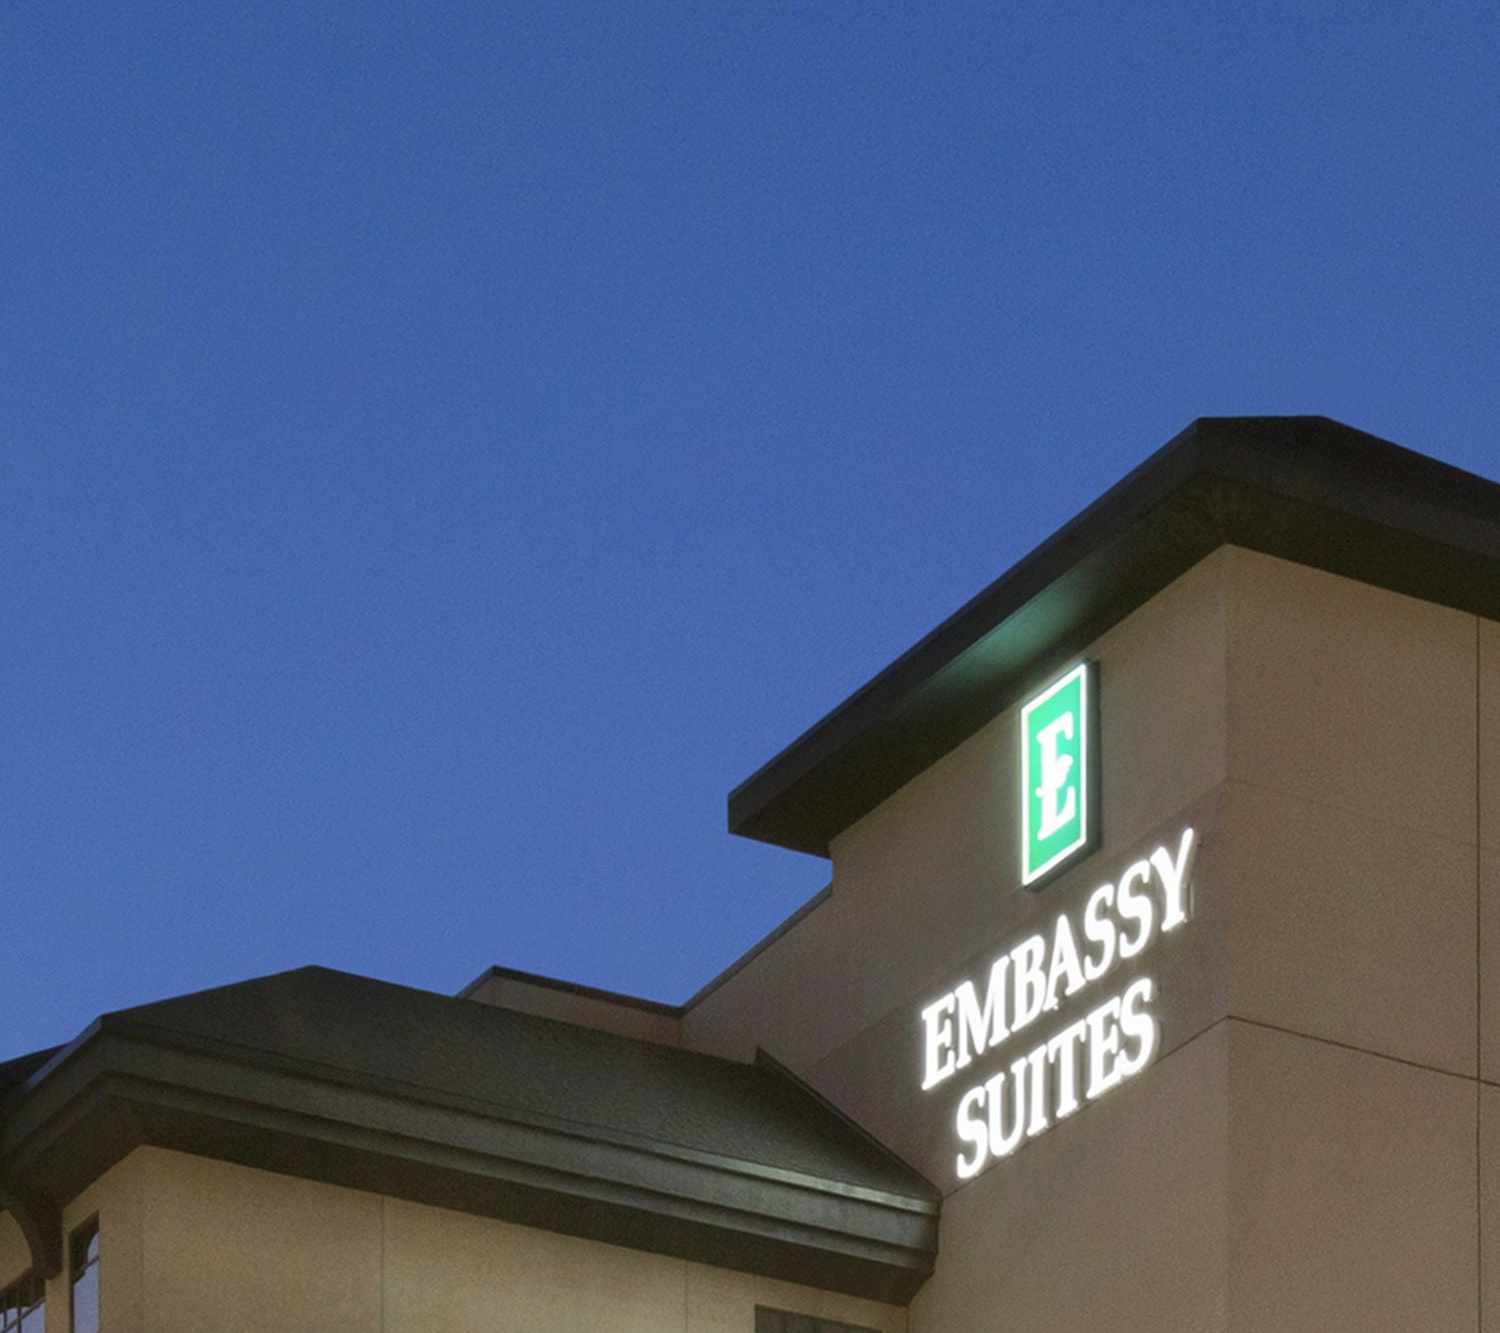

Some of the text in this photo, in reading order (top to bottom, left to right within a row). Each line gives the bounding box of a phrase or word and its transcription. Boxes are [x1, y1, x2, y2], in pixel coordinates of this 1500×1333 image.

[1035, 711, 1077, 842] E
[920, 827, 1195, 1092] EMBASSY
[955, 976, 1155, 1180] SUITES
